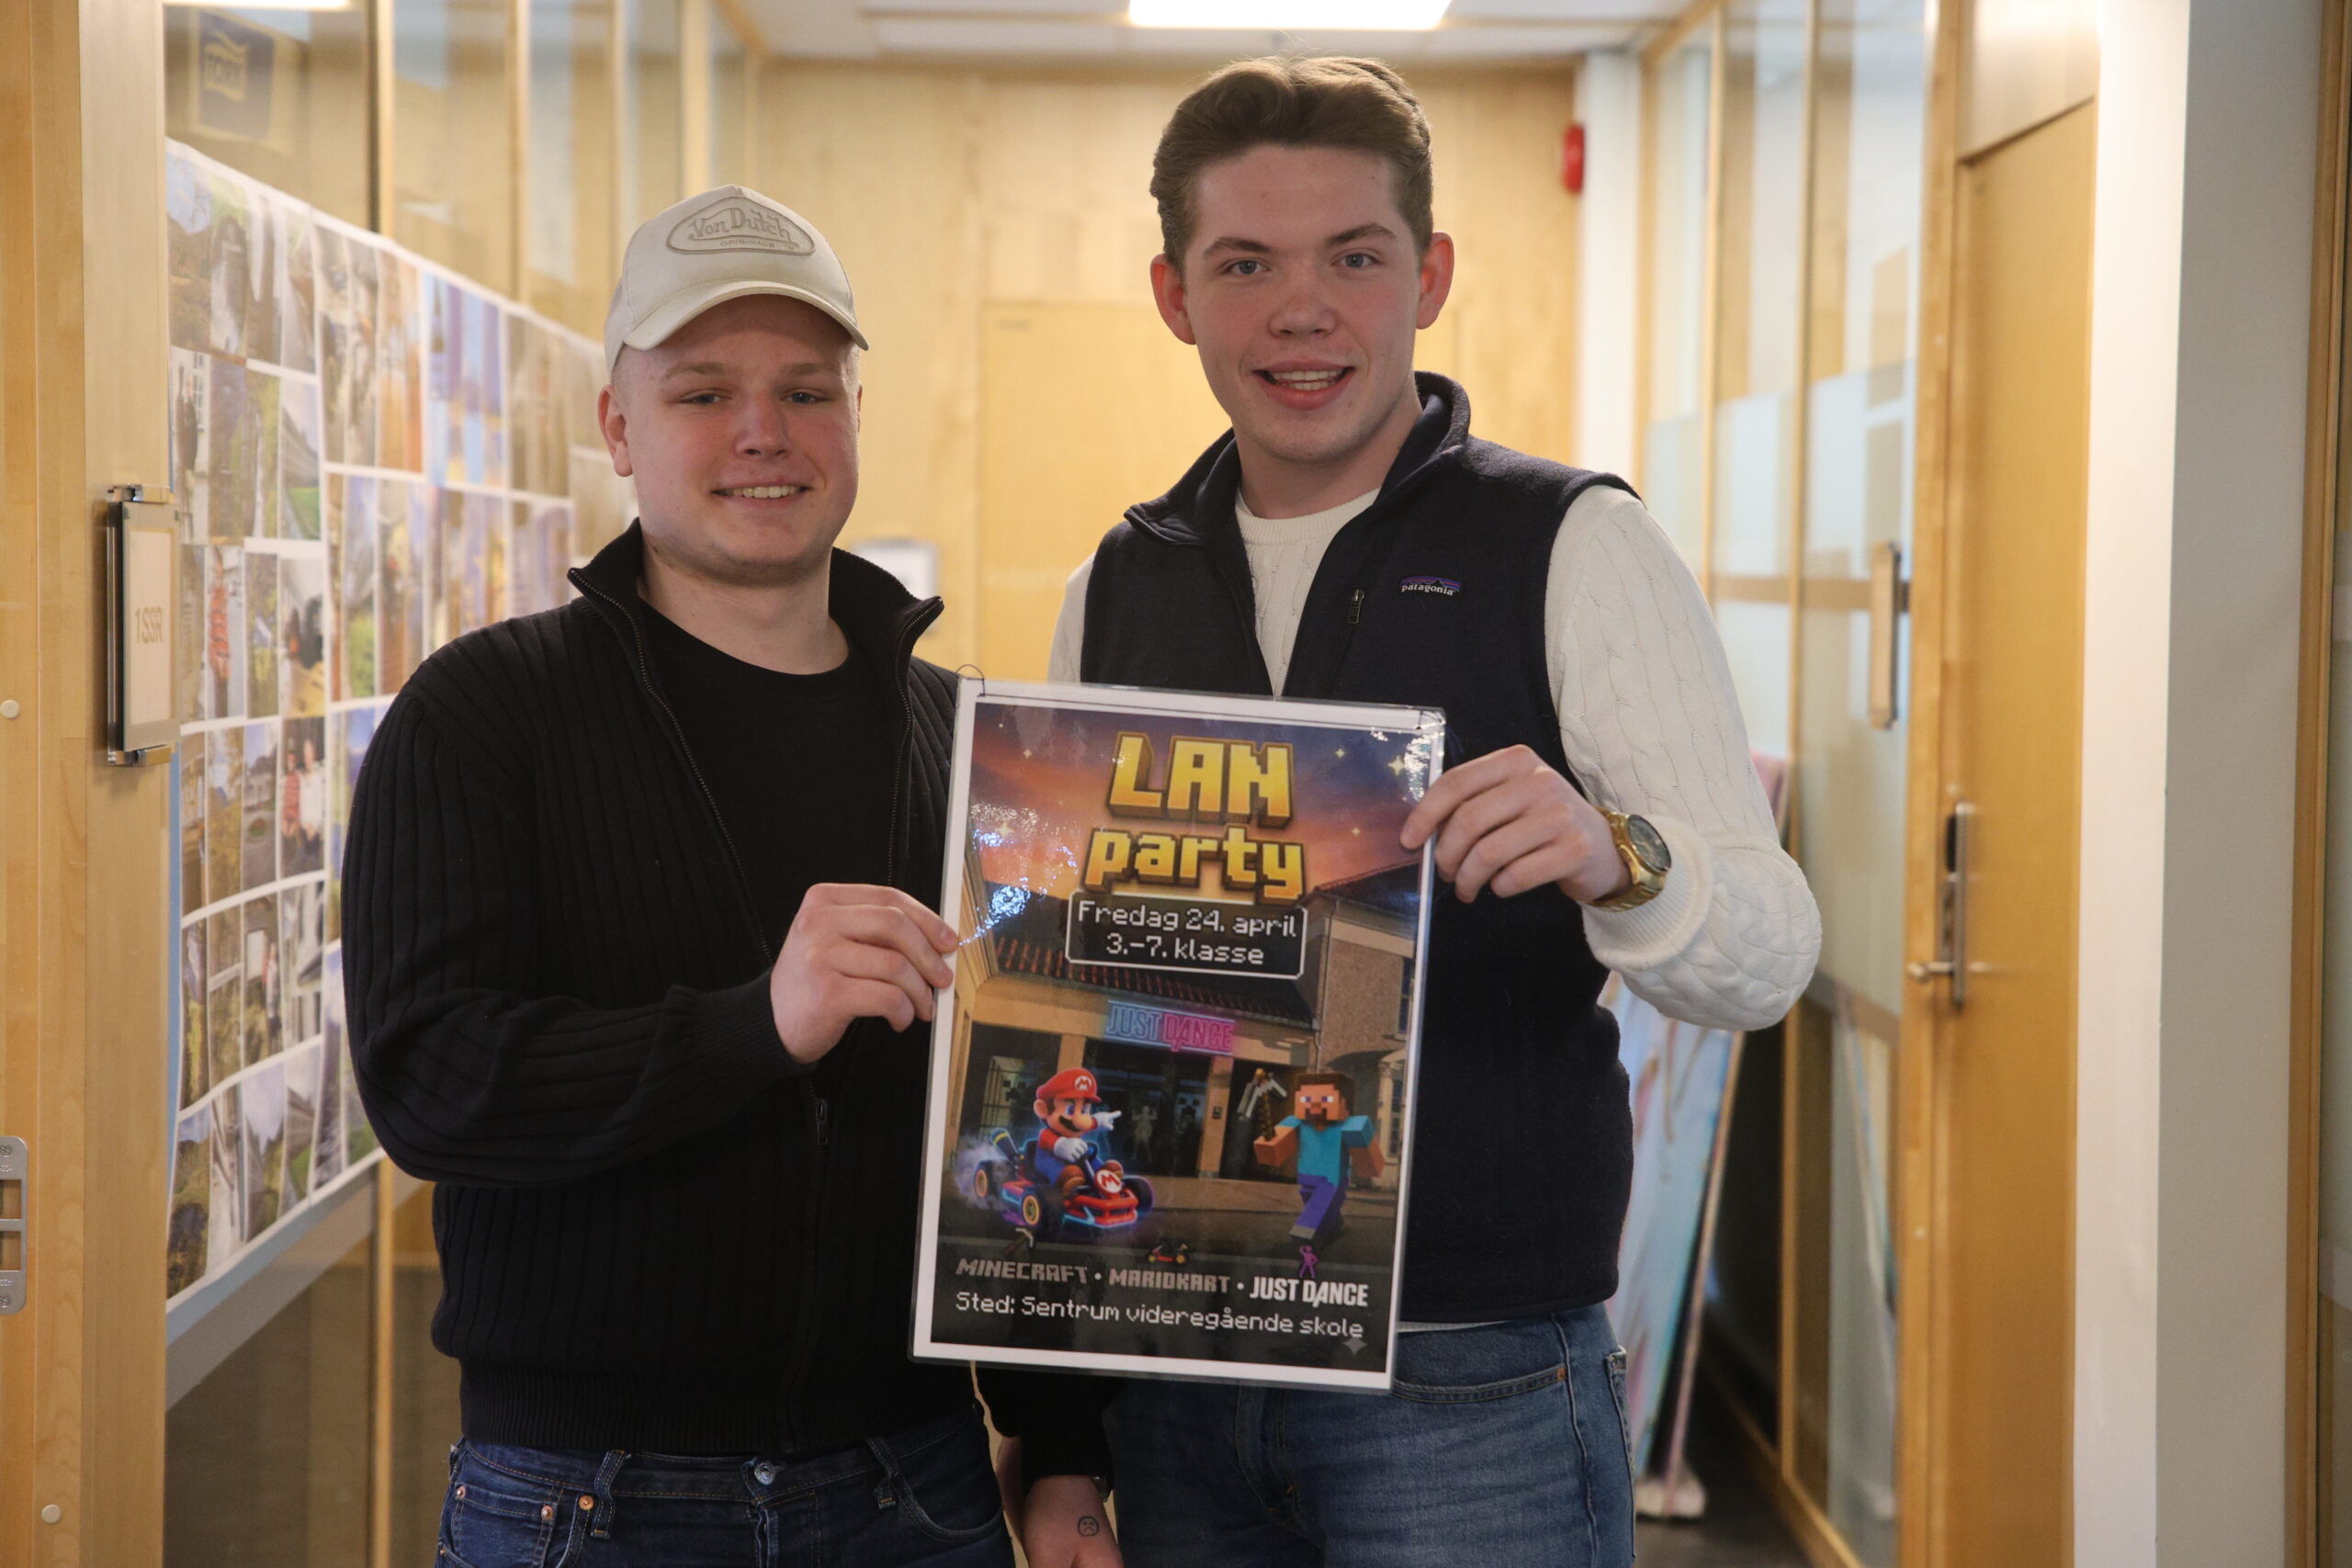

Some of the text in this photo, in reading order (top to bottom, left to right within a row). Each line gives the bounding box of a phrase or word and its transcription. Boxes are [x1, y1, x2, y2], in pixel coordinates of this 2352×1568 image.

[688, 208, 797, 244] Von Dutch
[1401, 584, 1453, 595] patagonia
[1106, 732, 1293, 828] LAN
[1081, 824, 1305, 904] party
[1078, 900, 1297, 937] Fredag 24. april
[1174, 938, 1265, 965] klasse
[1106, 1005, 1235, 1053] JUST DANCE
[956, 1258, 1368, 1307] MINECRAFT MARIOKART JUST DANCE
[956, 1292, 1363, 1338] Sted: Sentrum videregående skole
